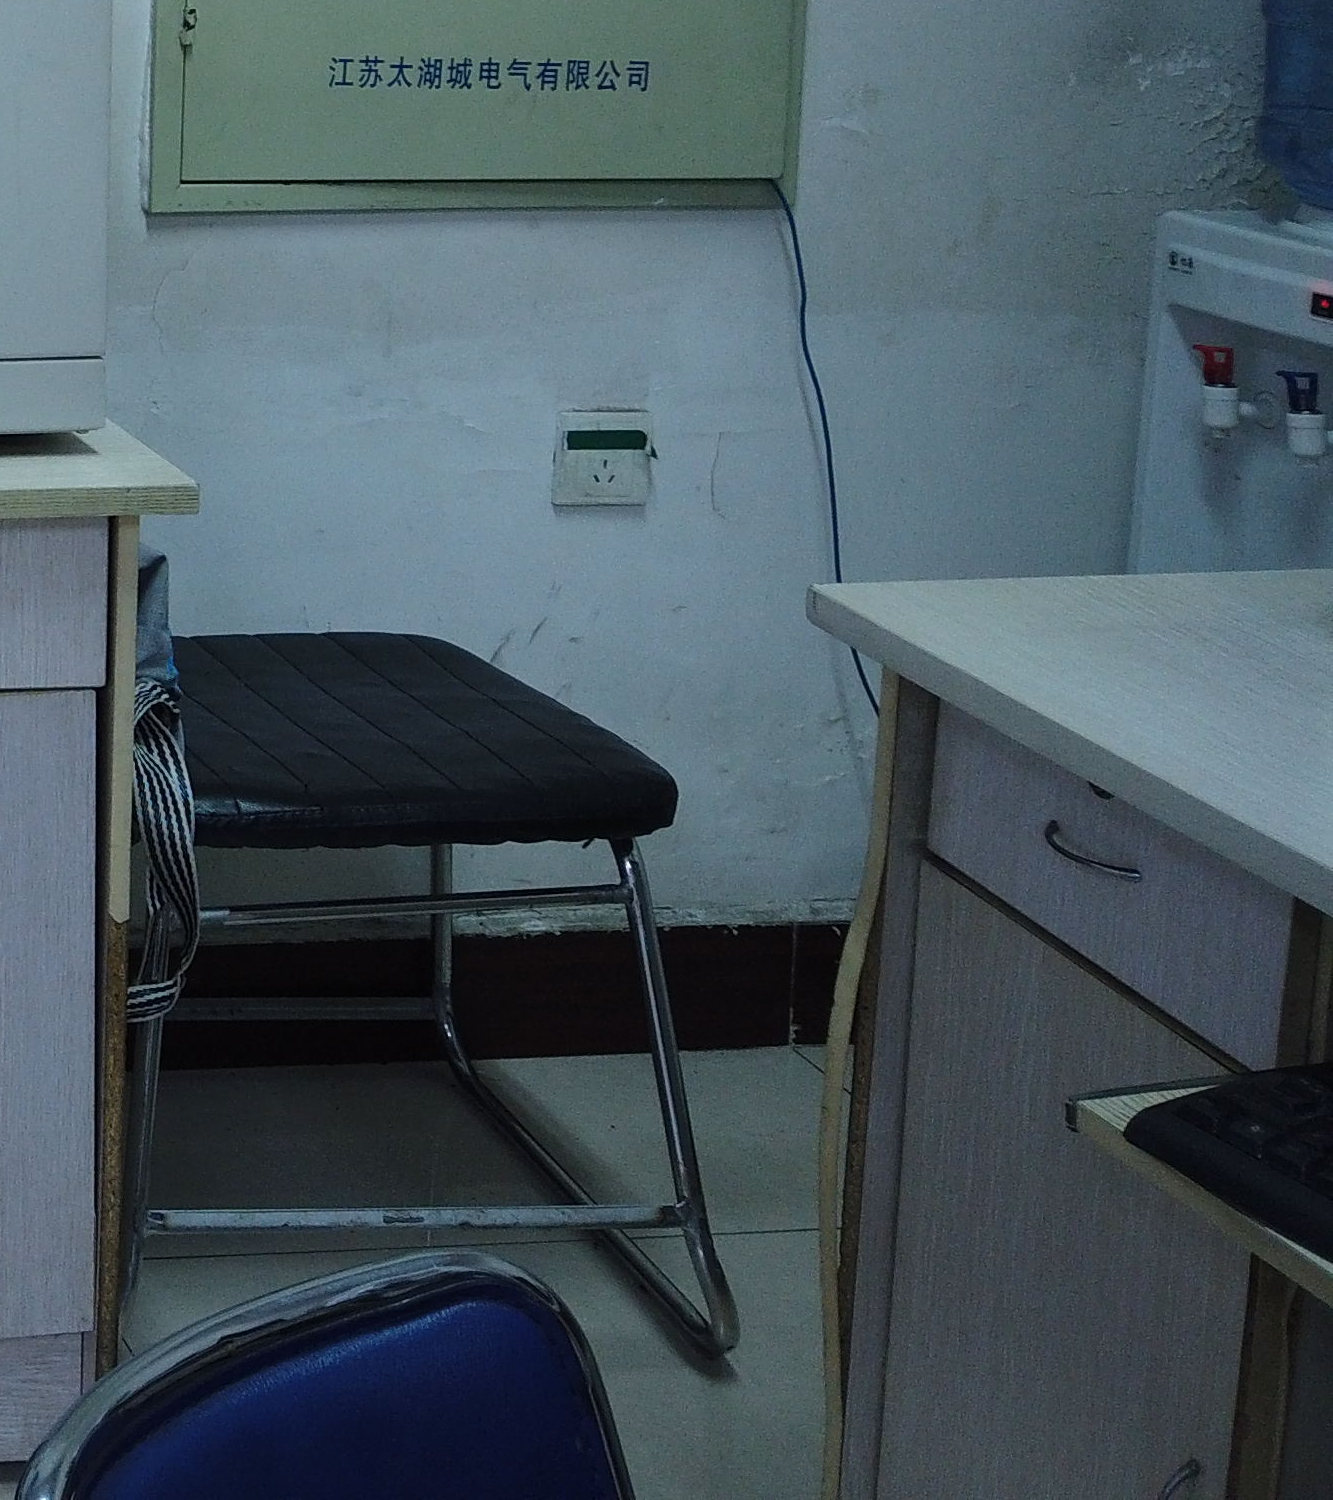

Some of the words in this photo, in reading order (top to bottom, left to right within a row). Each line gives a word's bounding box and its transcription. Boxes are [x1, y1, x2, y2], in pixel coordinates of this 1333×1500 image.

[328, 55, 652, 92] 江苏太湖城电气有限公司
